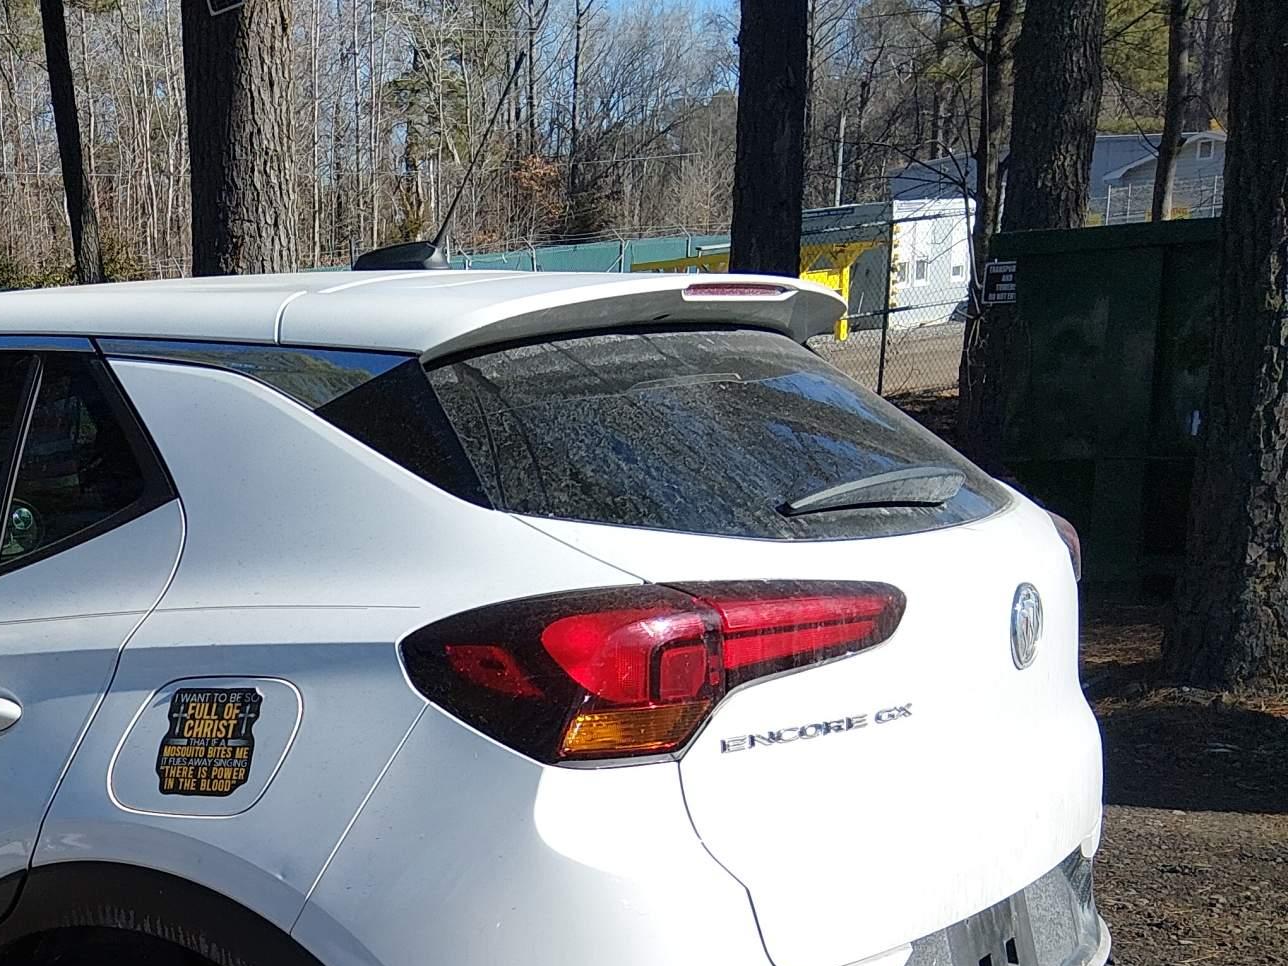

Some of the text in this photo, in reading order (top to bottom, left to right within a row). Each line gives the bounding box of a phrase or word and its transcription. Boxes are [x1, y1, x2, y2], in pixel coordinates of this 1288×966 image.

[180, 692, 212, 703] WANT
[213, 692, 228, 703] TO
[229, 692, 244, 703] BE
[187, 703, 241, 719] FULL OF
[183, 719, 237, 738] CHRIST
[720, 702, 913, 754] ENCORE GX
[189, 738, 211, 747] THAT
[219, 739, 226, 747] A
[163, 745, 249, 759] MOSQUITO BITES ME
[161, 757, 248, 768] IT FLIES AWAY SINGING
[197, 767, 208, 778] IS
[211, 767, 246, 780] POWER
[163, 779, 175, 790] IN
[178, 779, 197, 791] THE
